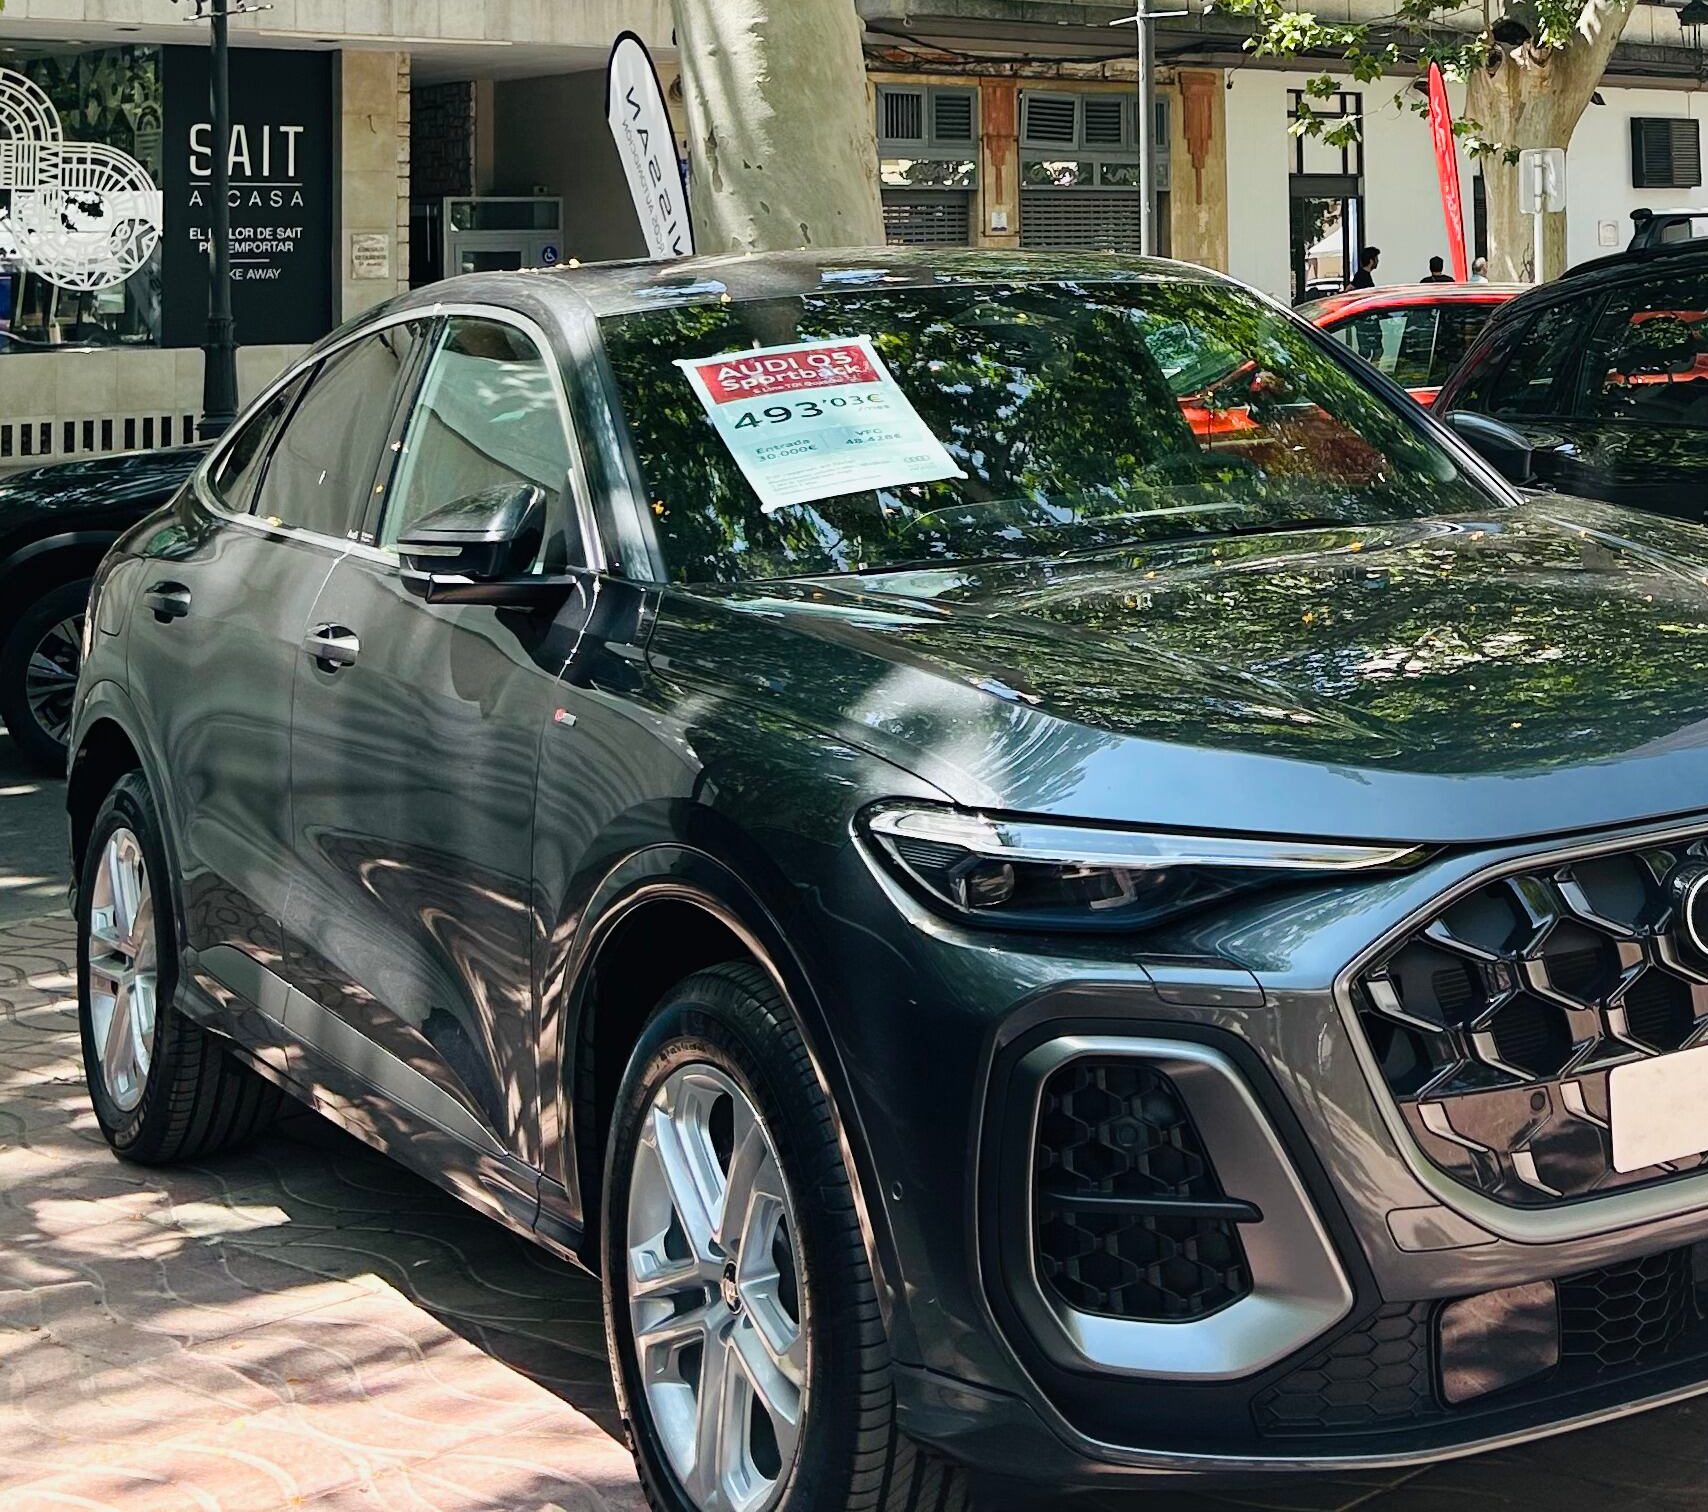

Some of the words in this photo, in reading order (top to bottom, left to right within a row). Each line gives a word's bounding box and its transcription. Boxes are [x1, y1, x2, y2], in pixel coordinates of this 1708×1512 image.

[189, 123, 304, 177] SAIT
[189, 227, 205, 239] EL
[256, 227, 274, 239] DE
[276, 227, 304, 239] SAIT
[246, 268, 282, 280] AWAY
[717, 357, 799, 381] AUDI
[720, 363, 864, 391] Sportback
